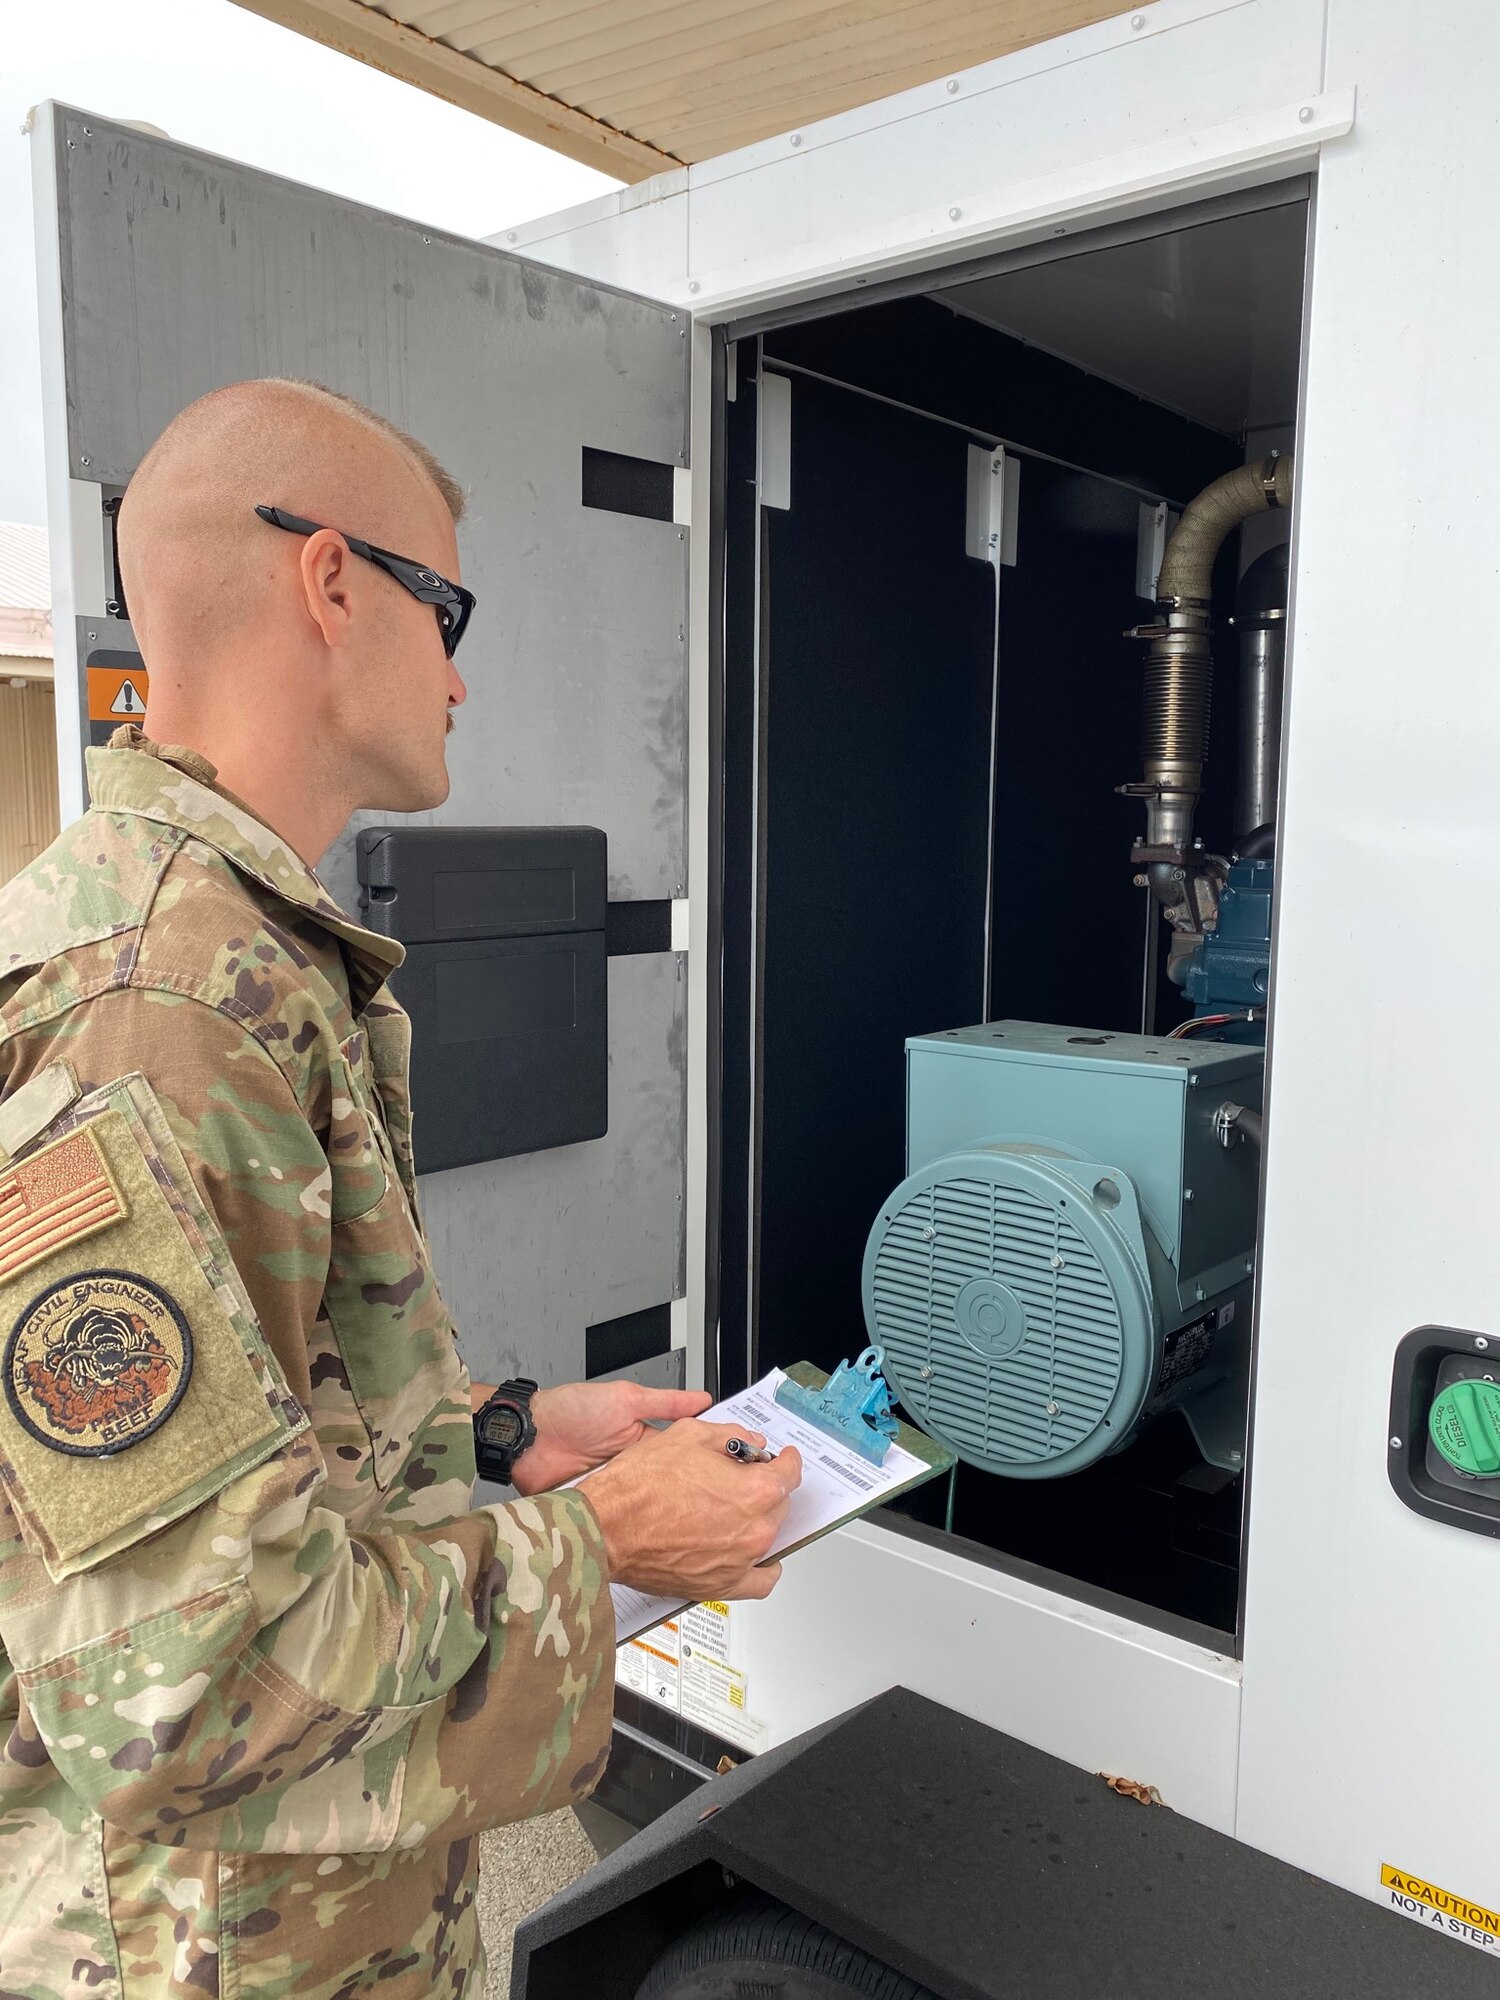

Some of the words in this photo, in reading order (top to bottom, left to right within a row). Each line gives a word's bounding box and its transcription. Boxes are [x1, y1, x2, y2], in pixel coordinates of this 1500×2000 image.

[15, 1340, 29, 1394] USAF
[27, 1295, 68, 1334] CIVIL
[73, 1282, 164, 1319] ENGINEER
[90, 1391, 153, 1432] PRIME
[101, 1407, 154, 1442] BEEF
[1435, 1405, 1445, 1424] CLICKS
[1436, 1426, 1445, 1441] UNTIL
[1449, 1415, 1467, 1448] DIESEL
[1442, 1440, 1461, 1460] TIGHTEN
[703, 1601, 728, 1615] UTION
[1391, 1891, 1429, 1918] NOT
[1431, 1912, 1444, 1927] A
[1447, 1918, 1495, 1946] STEP
[1406, 1880, 1499, 1932] CAUTION
